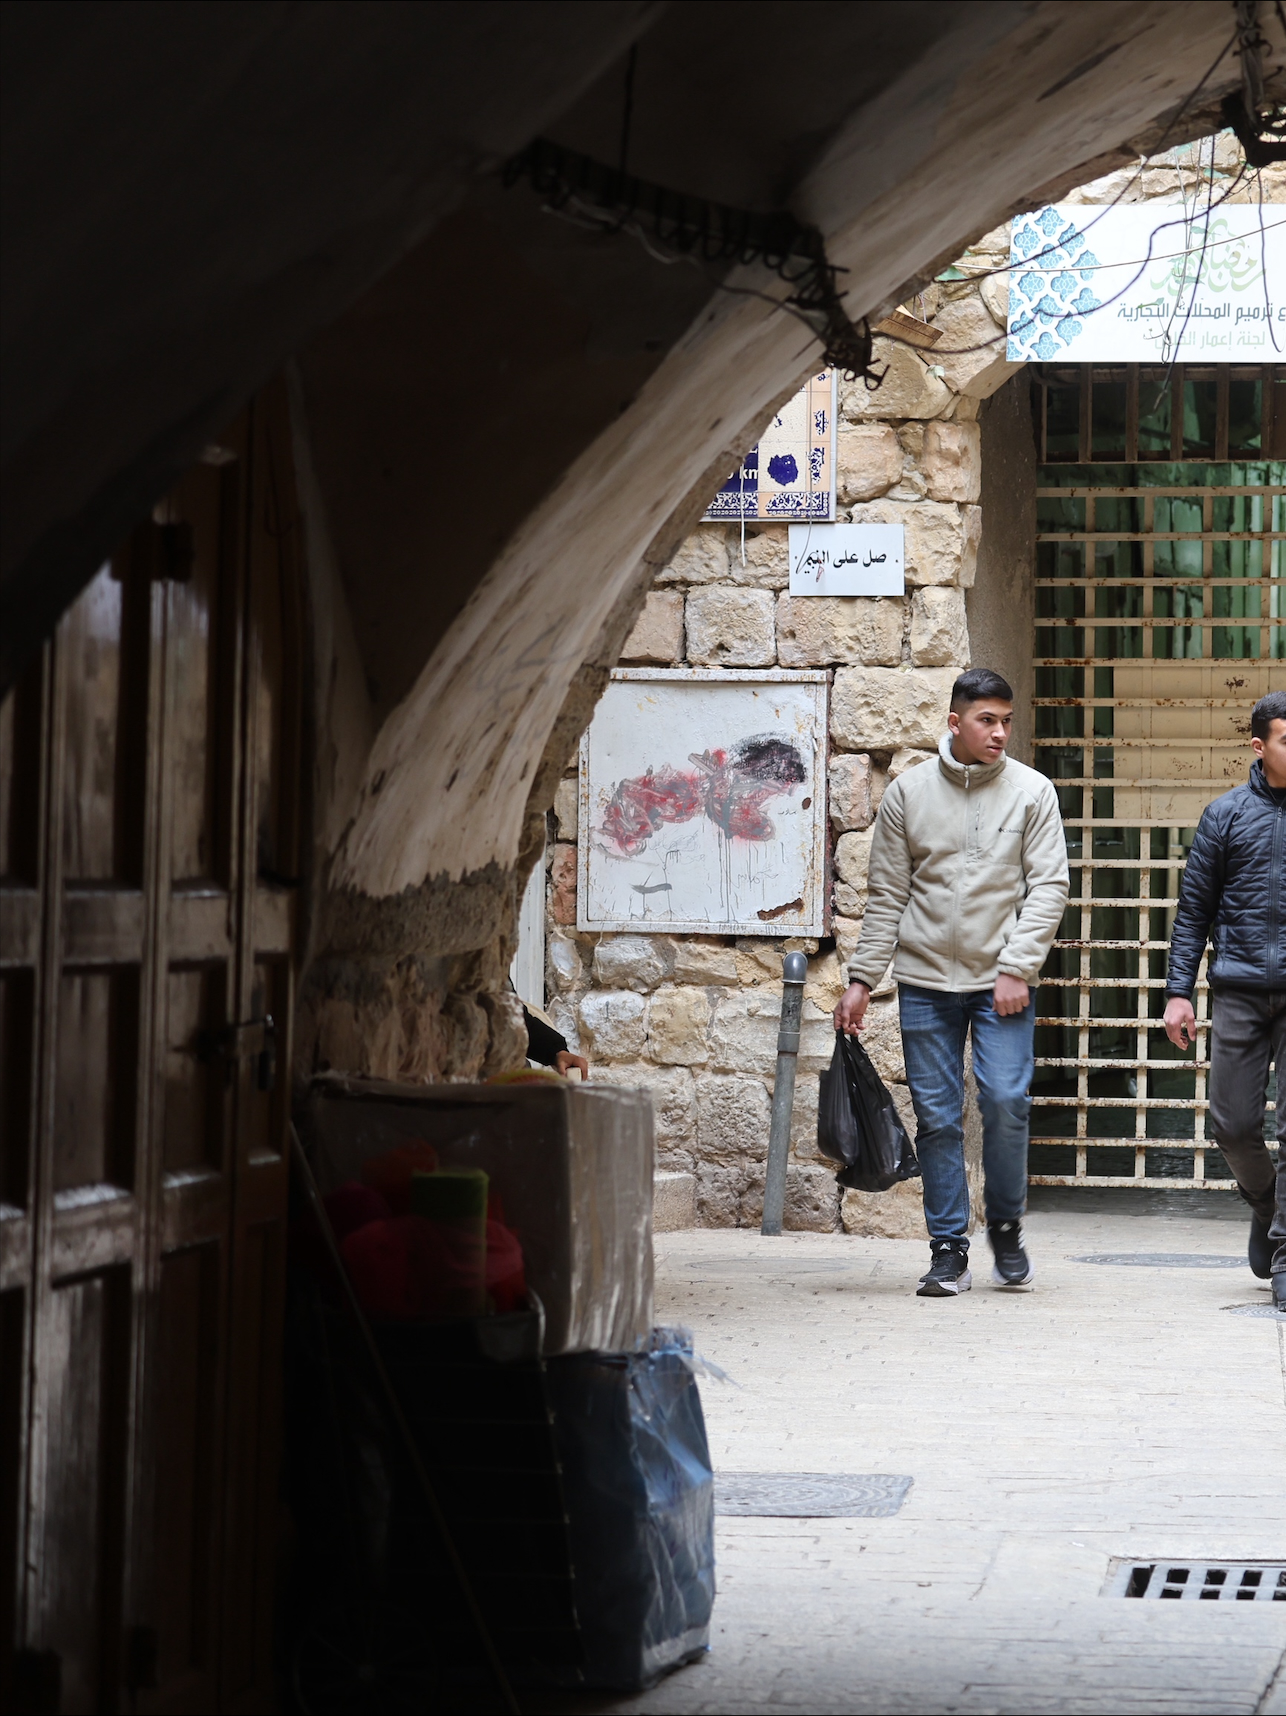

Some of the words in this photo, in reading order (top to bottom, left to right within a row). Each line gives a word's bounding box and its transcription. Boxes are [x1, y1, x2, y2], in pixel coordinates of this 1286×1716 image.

[1234, 301, 1273, 325] ترميم
[1201, 332, 1232, 350] إعمار
[1236, 331, 1266, 347] لجنة
[832, 548, 859, 569] على
[862, 548, 887, 568] صل
